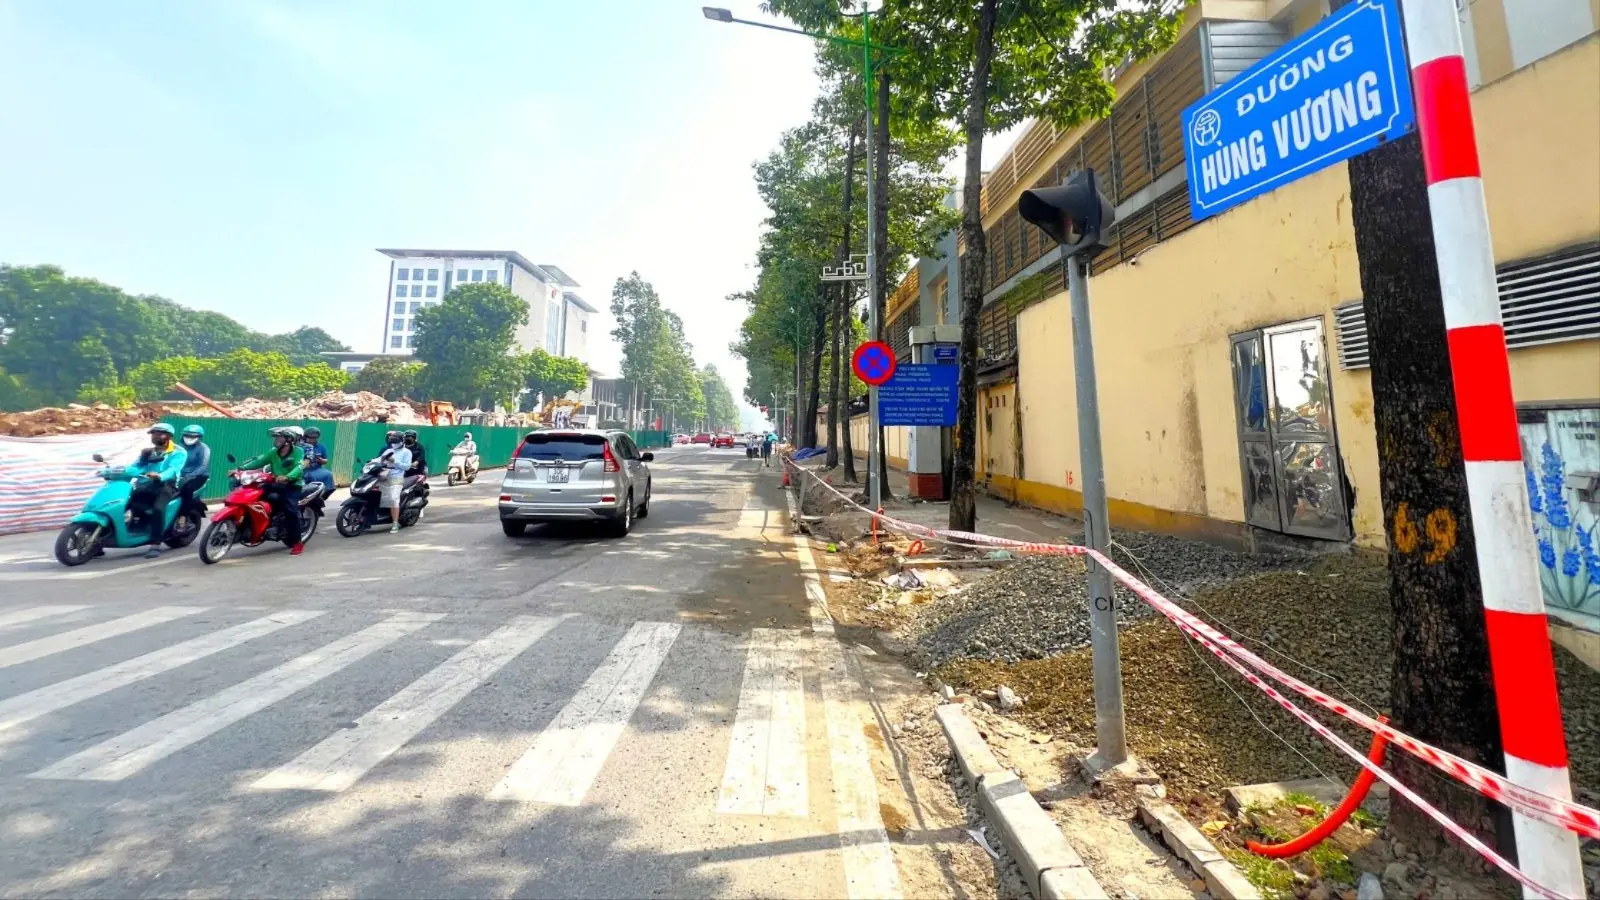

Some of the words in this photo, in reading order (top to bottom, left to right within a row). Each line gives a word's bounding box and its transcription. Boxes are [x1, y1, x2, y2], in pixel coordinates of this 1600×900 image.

[1236, 34, 1355, 117] ĐƯỜNG
[1201, 129, 1267, 194] HÙNG
[1272, 70, 1383, 160] VƯƠNG
